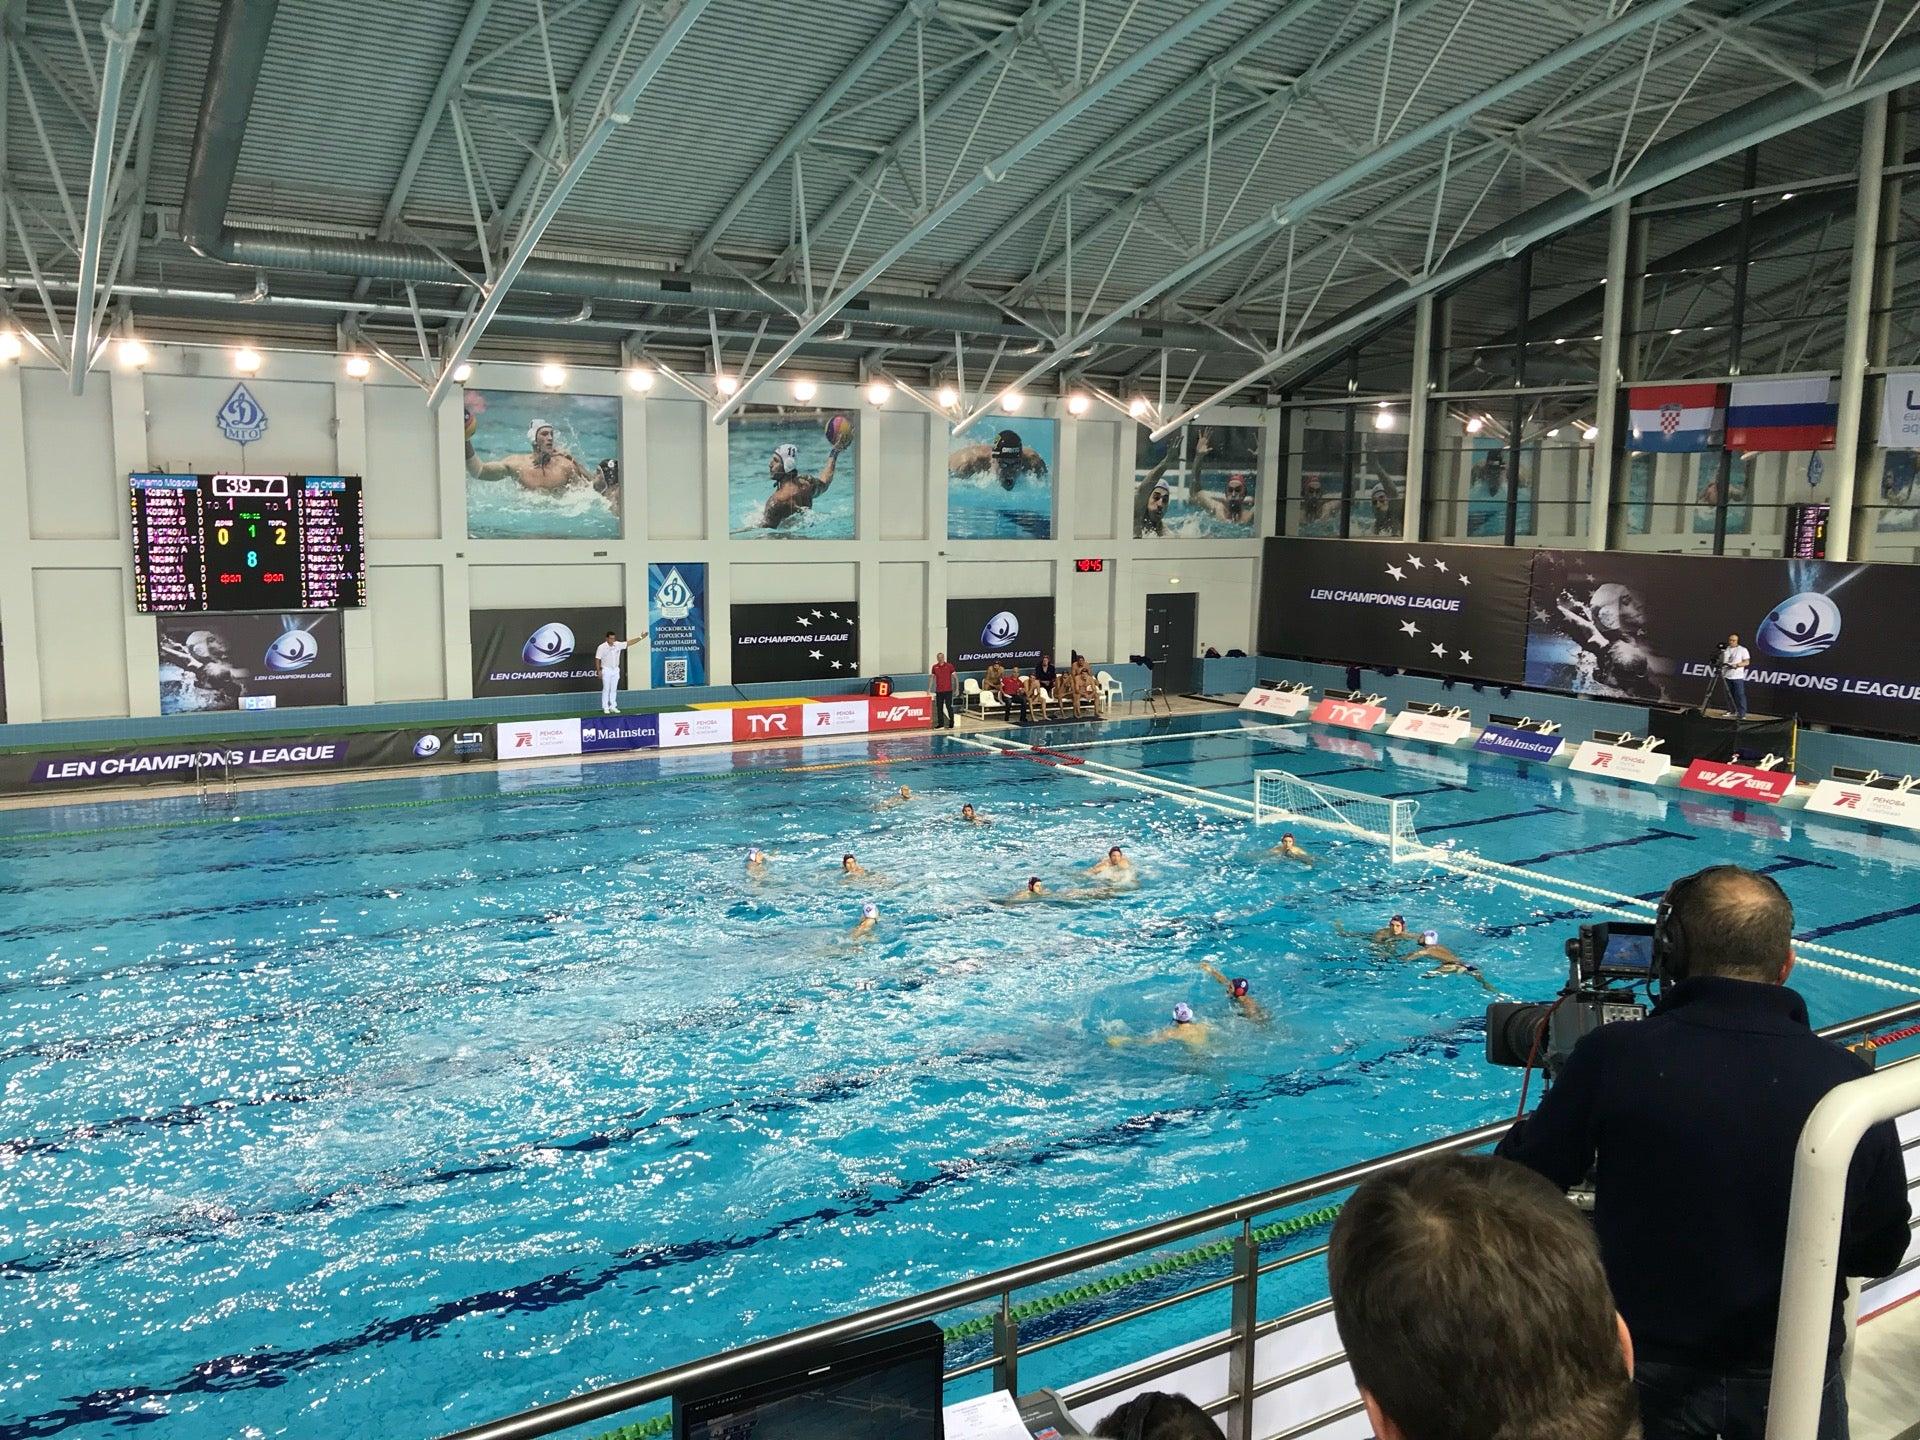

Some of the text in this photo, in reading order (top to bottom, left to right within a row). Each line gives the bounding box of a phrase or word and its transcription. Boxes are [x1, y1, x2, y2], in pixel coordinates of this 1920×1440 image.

[130, 478, 198, 488] Dynamo Moscow
[226, 479, 276, 493] 39.7
[306, 481, 319, 490] Jug
[226, 498, 234, 510] 1
[285, 498, 292, 511] 1
[218, 528, 228, 546] 0
[248, 524, 256, 538] 1
[276, 528, 286, 545] 2
[247, 551, 258, 568] 8
[136, 575, 146, 583] 10
[357, 572, 365, 580] 10
[137, 593, 147, 601] 12
[1310, 588, 1460, 612] LEN CHAMPIONS LEAGUE
[138, 604, 148, 612] 13
[738, 634, 848, 644] LEN CHAMPIONS LEAGUE
[973, 652, 1014, 660] CHAMPIONS
[510, 671, 568, 680] CHAMPIONS
[570, 670, 599, 678] LEAGU
[1328, 704, 1366, 724] TYR
[747, 714, 788, 732] TYR
[454, 732, 482, 744] LEN
[598, 726, 656, 740] Malmsten
[1495, 736, 1554, 754] Malmsten
[46, 745, 336, 779] LEN CHAMPIONS LEAGUE
[1241, 980, 1246, 988] 9
